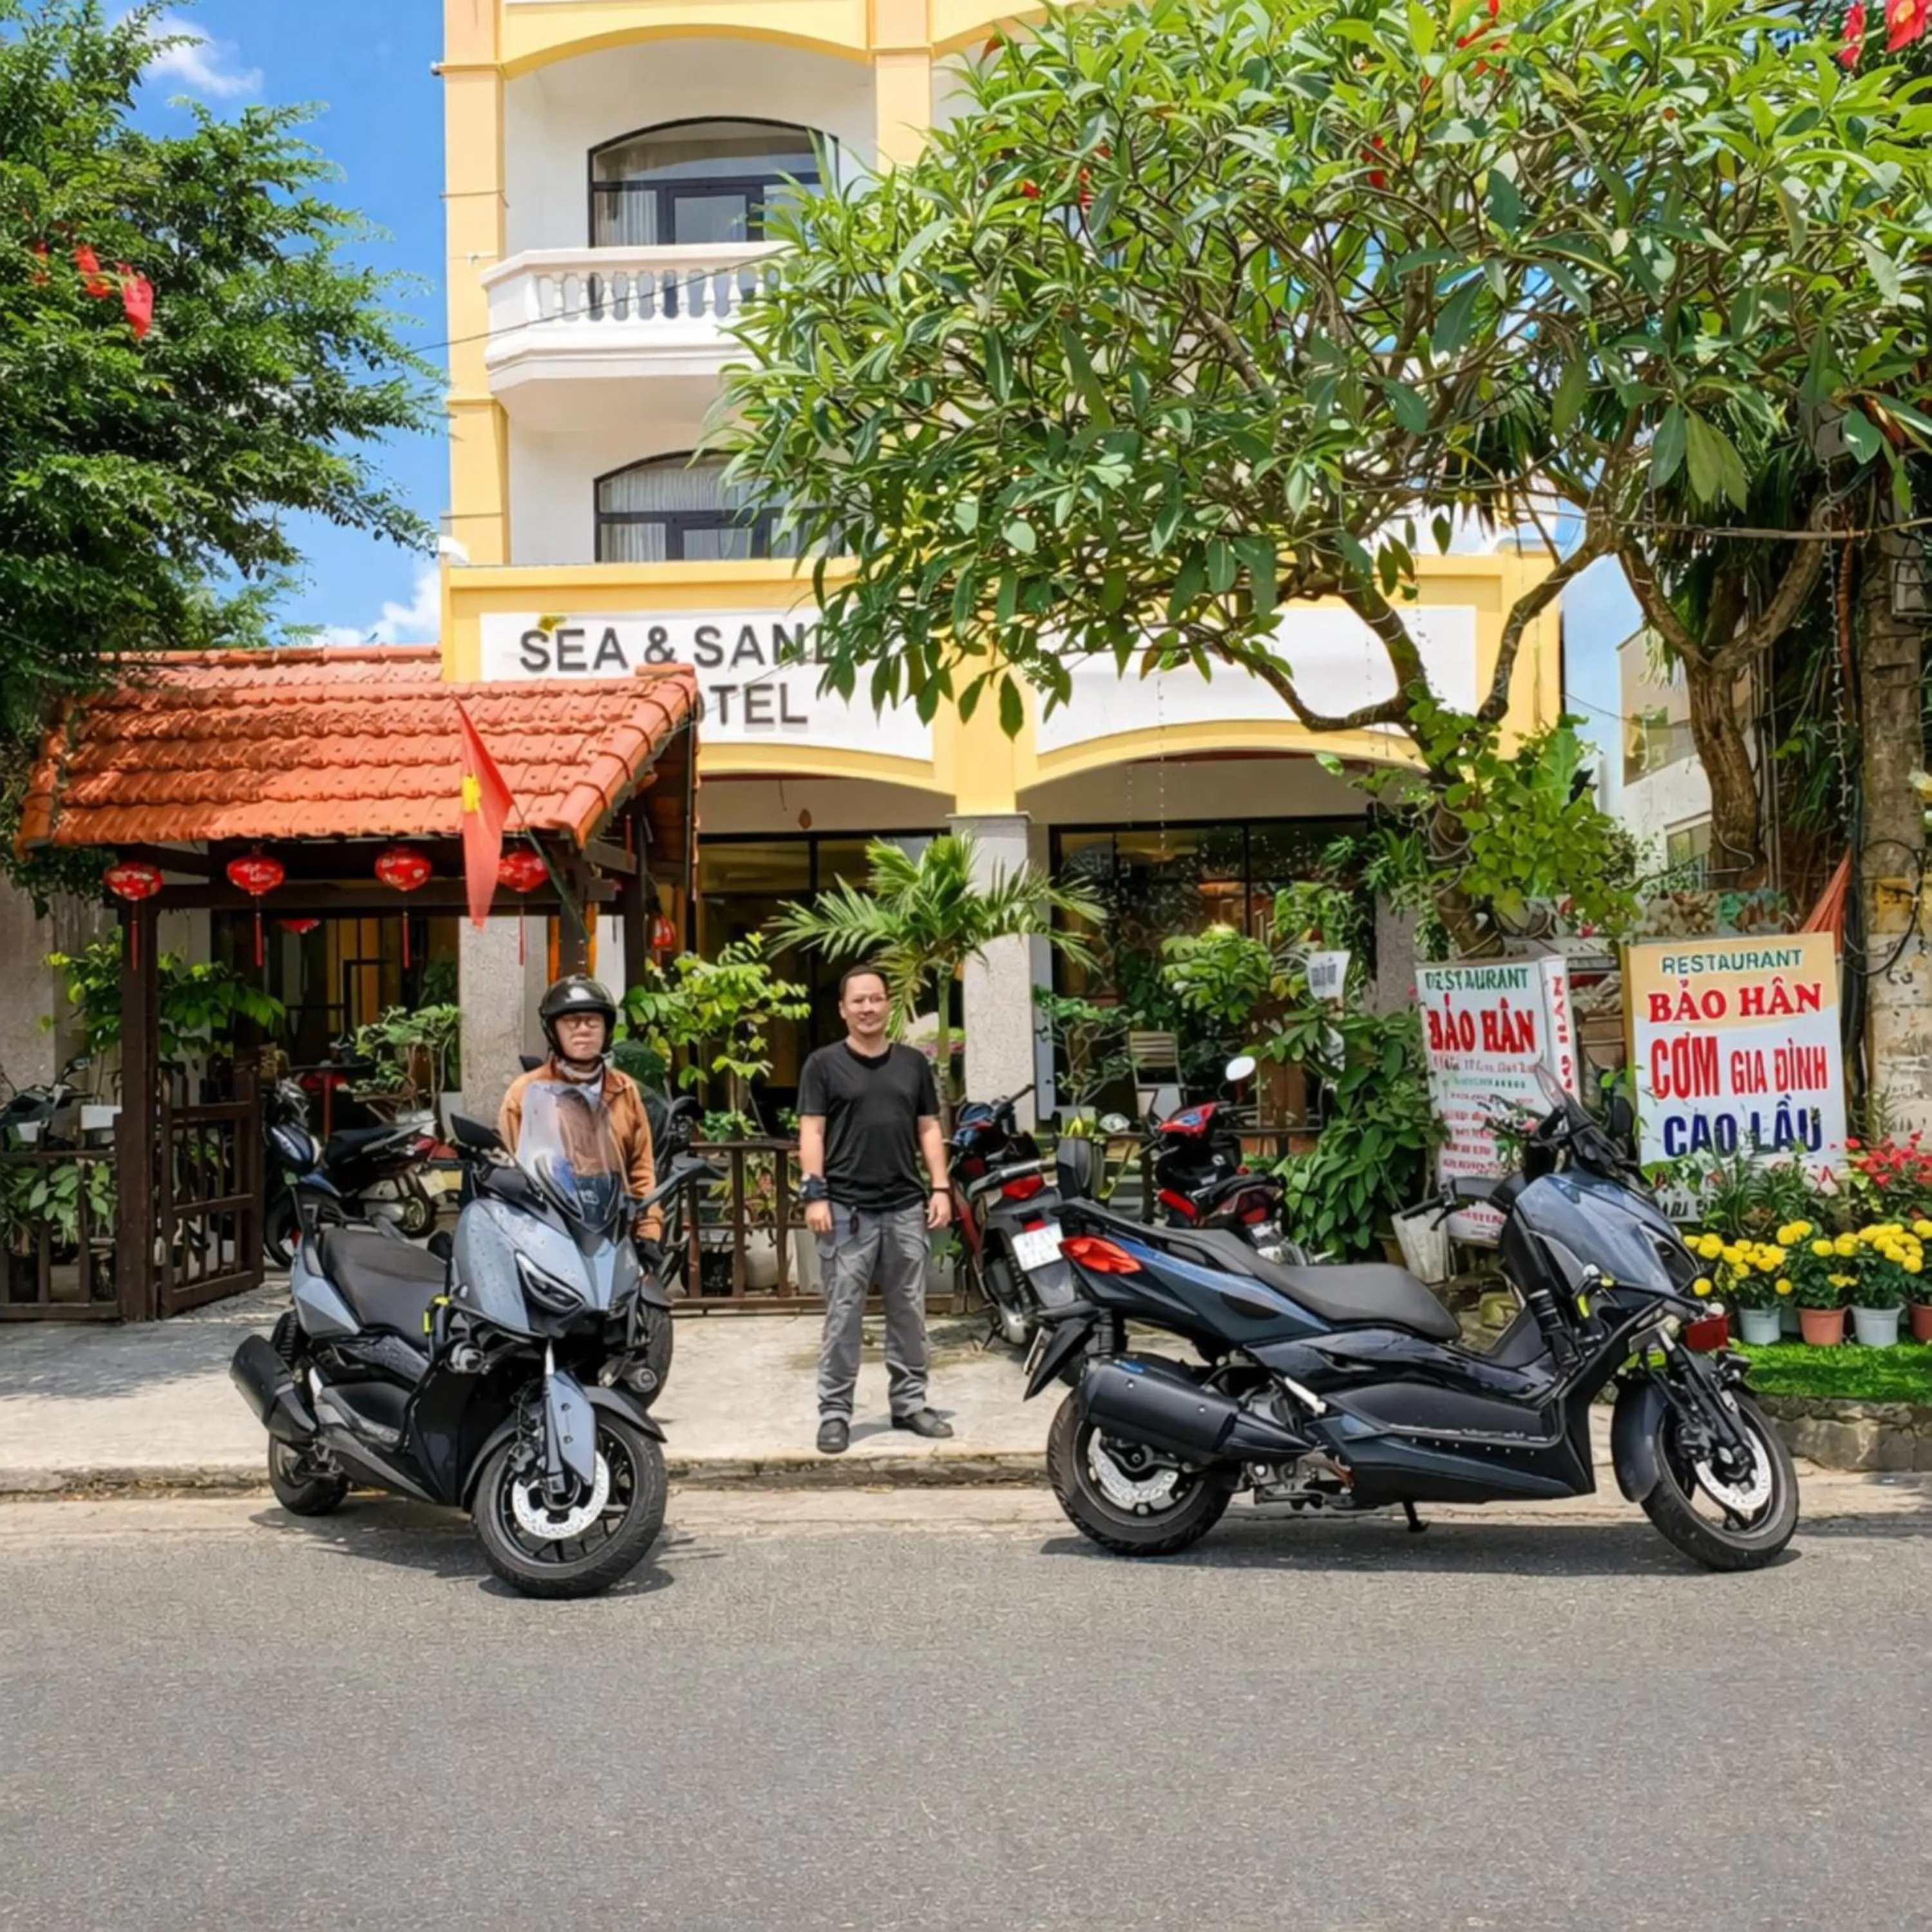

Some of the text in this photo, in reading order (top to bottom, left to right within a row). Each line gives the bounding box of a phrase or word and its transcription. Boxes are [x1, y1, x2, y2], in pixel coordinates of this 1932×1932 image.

[520, 627, 629, 673] SEA
[644, 625, 678, 664] &
[698, 682, 808, 726] TEL
[1662, 949, 1802, 974] RESTAURANT
[1647, 976, 1821, 1023] BẢO HÂN
[1651, 1032, 1828, 1100] CƠM GIA ĐÌNH
[1663, 1113, 1738, 1159] CAO
